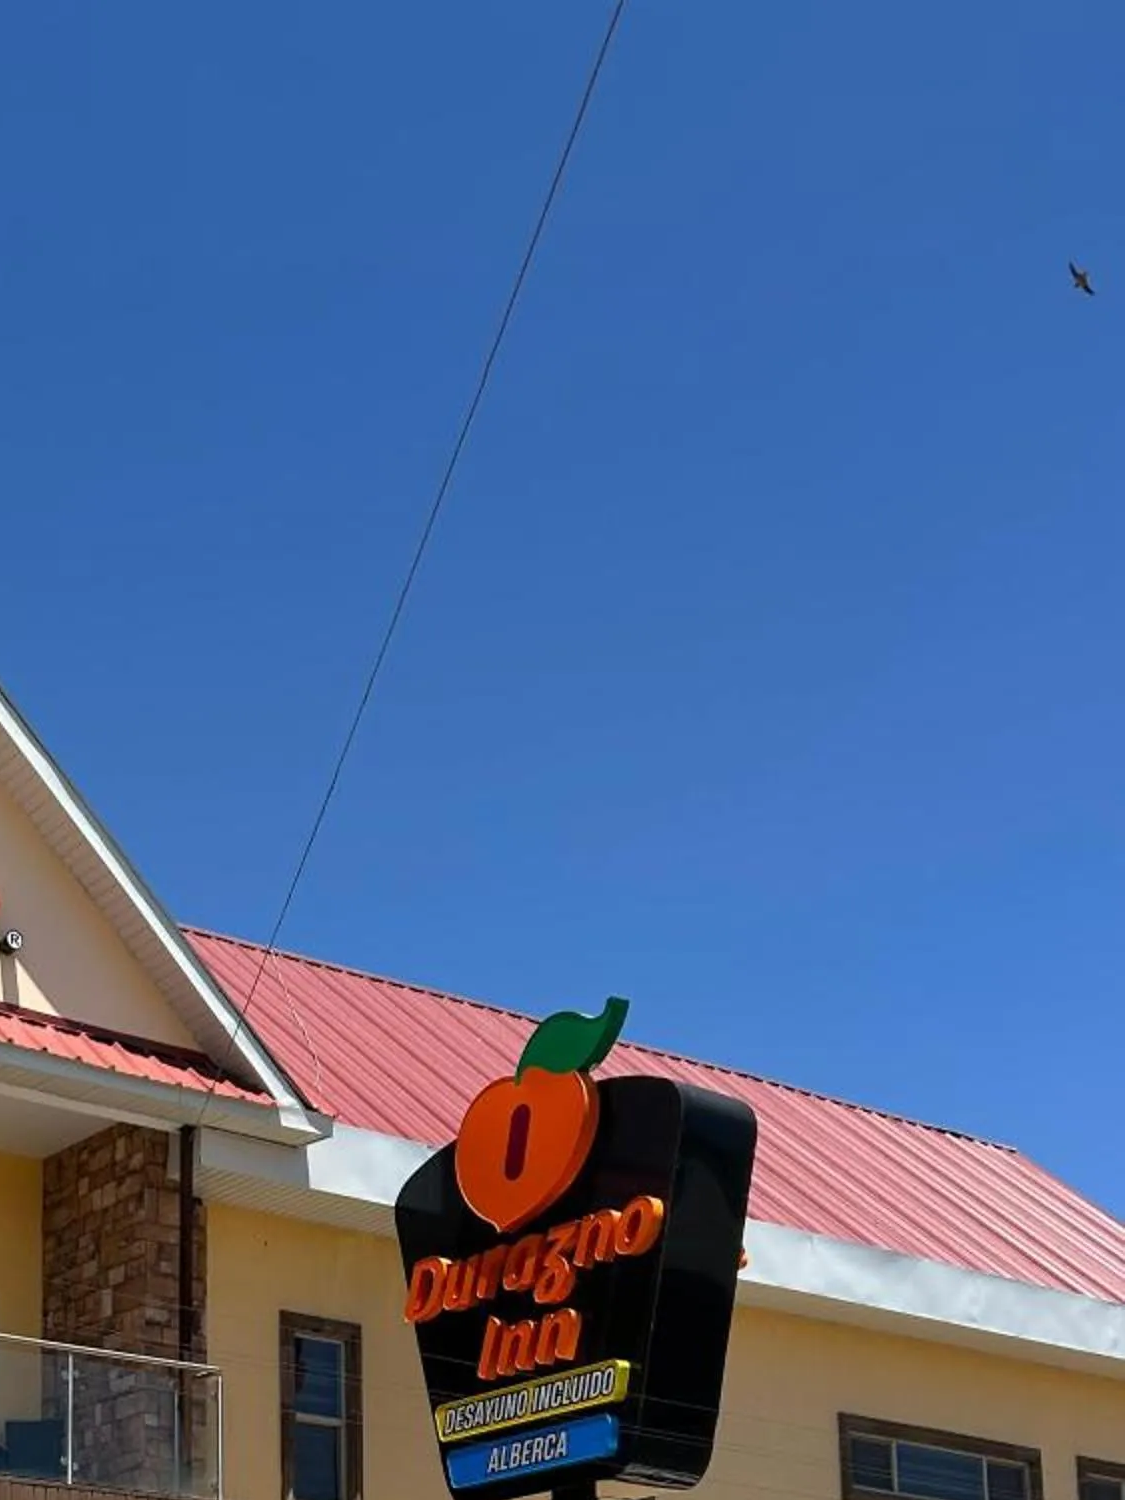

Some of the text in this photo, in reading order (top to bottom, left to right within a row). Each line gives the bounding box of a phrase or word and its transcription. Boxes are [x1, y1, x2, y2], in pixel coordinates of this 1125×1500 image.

[405, 1195, 664, 1323] Durazno
[477, 1308, 581, 1380] Inn
[444, 1367, 615, 1434] DESAYUNO INCLUIDO
[487, 1431, 567, 1473] ALBERCA
